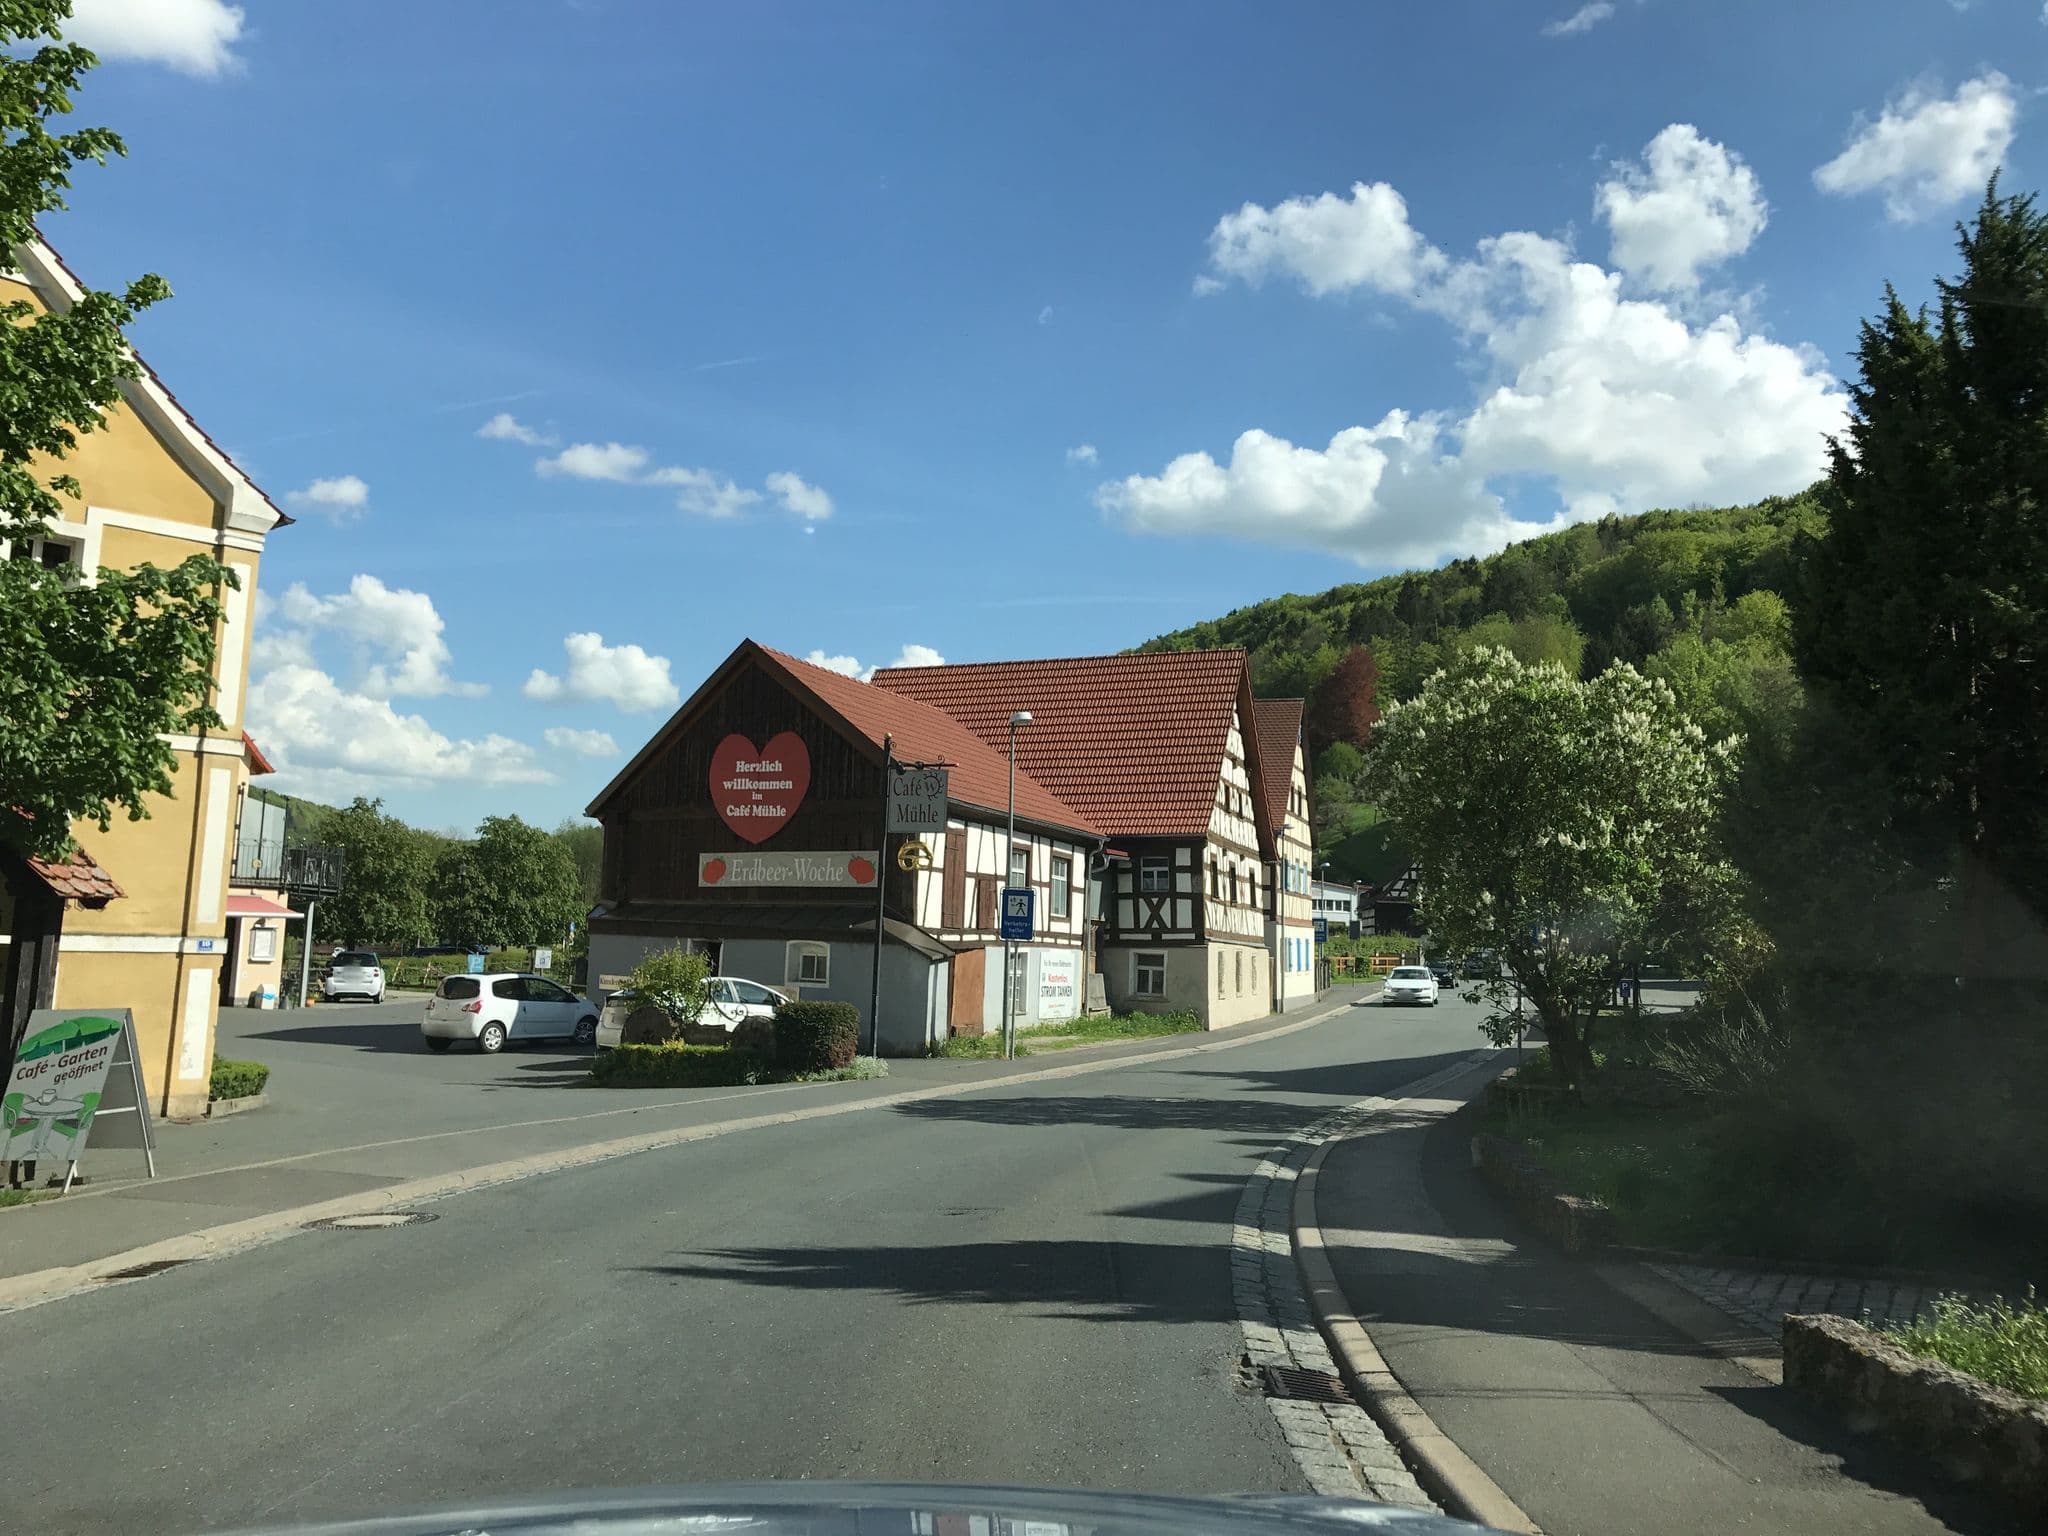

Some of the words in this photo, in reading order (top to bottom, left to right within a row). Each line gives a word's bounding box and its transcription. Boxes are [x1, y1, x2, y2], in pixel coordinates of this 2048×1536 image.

[736, 761, 782, 772] Herzlich
[723, 779, 793, 789] willkommen
[893, 777, 921, 796] Café
[752, 792, 762, 800] im
[727, 805, 751, 816] Café
[752, 805, 786, 816] Mühle
[896, 804, 938, 823] Mühle
[730, 857, 844, 882] Erdbeer-Woche
[1622, 982, 1628, 990] P
[16, 1060, 49, 1081] Café
[58, 1046, 107, 1068] Garten
[53, 1061, 103, 1085] geöffnet
